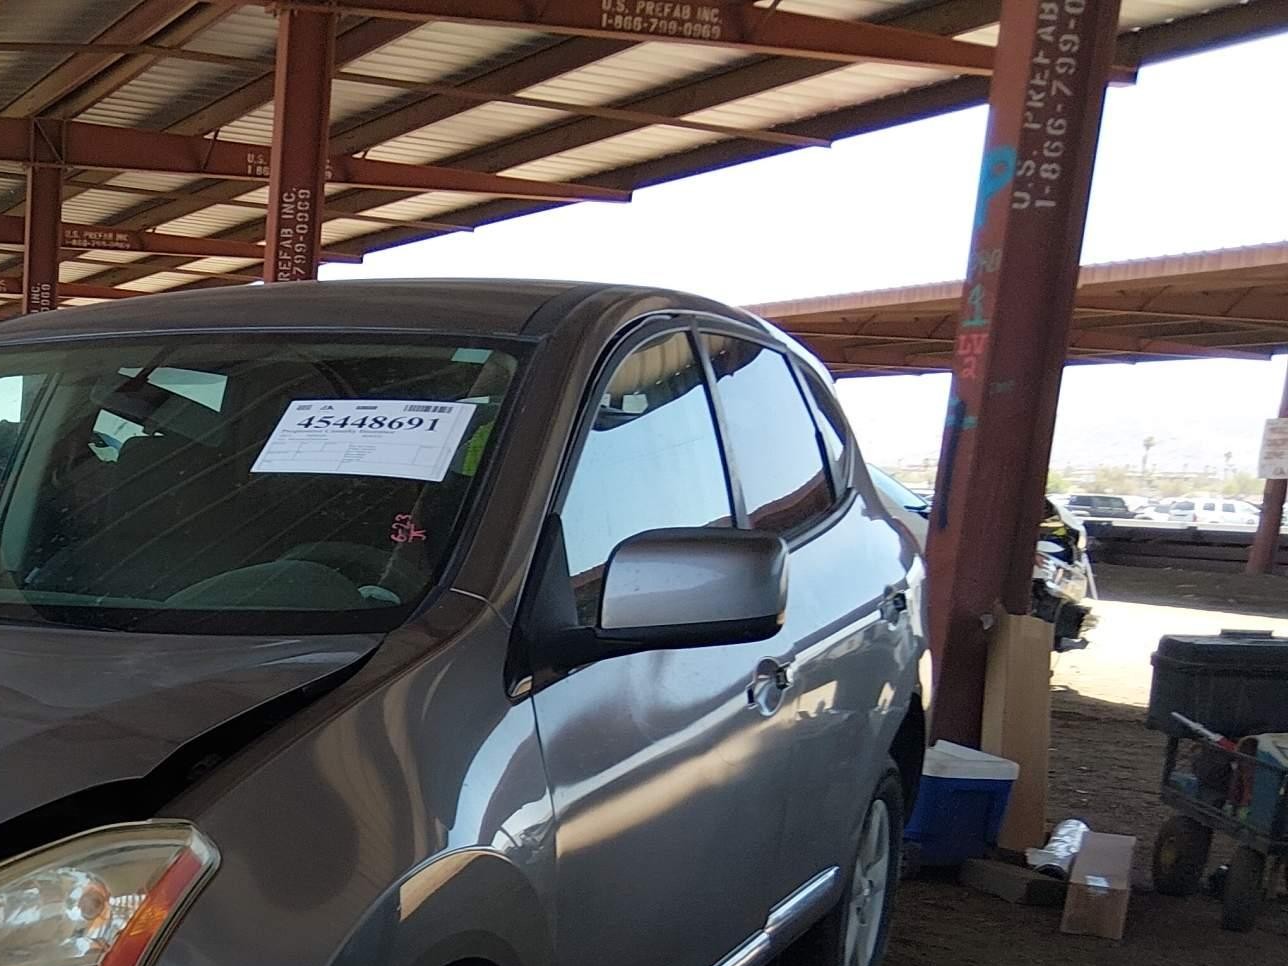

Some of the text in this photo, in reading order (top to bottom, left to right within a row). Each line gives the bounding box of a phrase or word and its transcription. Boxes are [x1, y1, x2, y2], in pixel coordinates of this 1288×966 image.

[601, 0, 722, 24] U.S. PREFAB INC.
[1023, 2, 1059, 129] PREFAB
[278, 228, 294, 281] REFAB
[297, 415, 440, 432] 45448691
